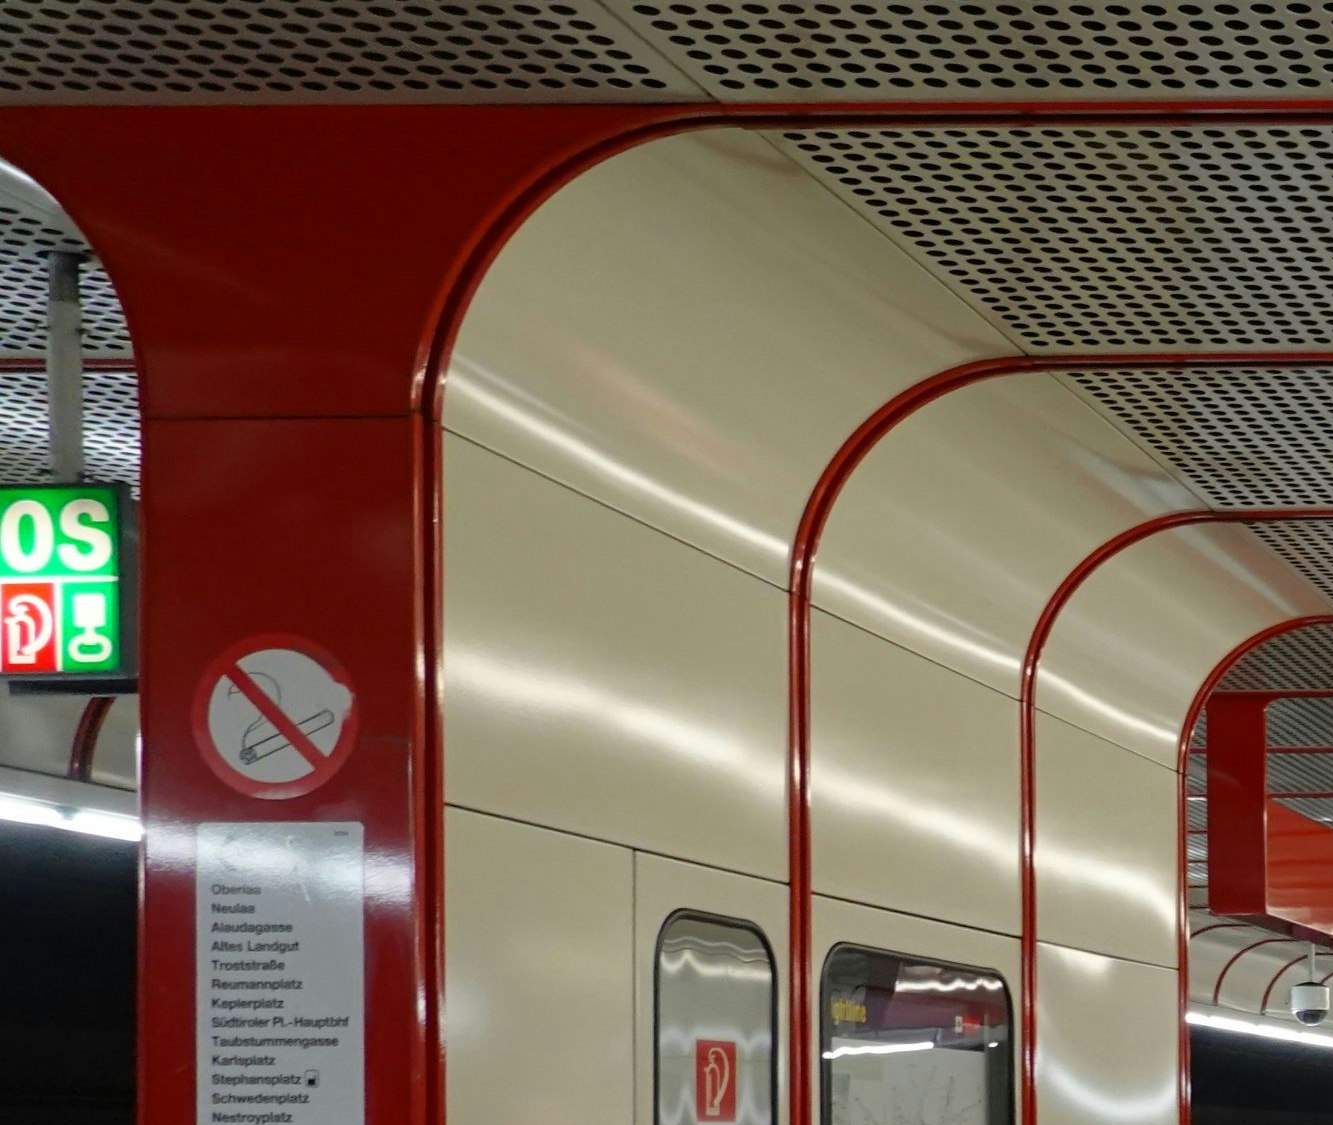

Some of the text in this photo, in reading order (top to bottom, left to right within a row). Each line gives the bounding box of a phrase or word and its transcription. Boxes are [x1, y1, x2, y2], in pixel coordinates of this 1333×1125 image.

[211, 883, 262, 897] Oberlaa
[211, 902, 256, 915] Neulaa
[210, 920, 293, 936] Alaudagasse
[211, 939, 300, 955] Altes Landgut
[211, 958, 286, 972] Troststraße
[211, 977, 303, 992] Reumannplatz
[211, 997, 285, 1012] Keplerplatz
[211, 1015, 269, 1030] Südtiroler
[211, 1034, 339, 1050] Taubstummengasse
[211, 1053, 276, 1069] Karlsplatz
[211, 1072, 302, 1088] Stephansplatz
[211, 1091, 310, 1106] Schwedenplatz
